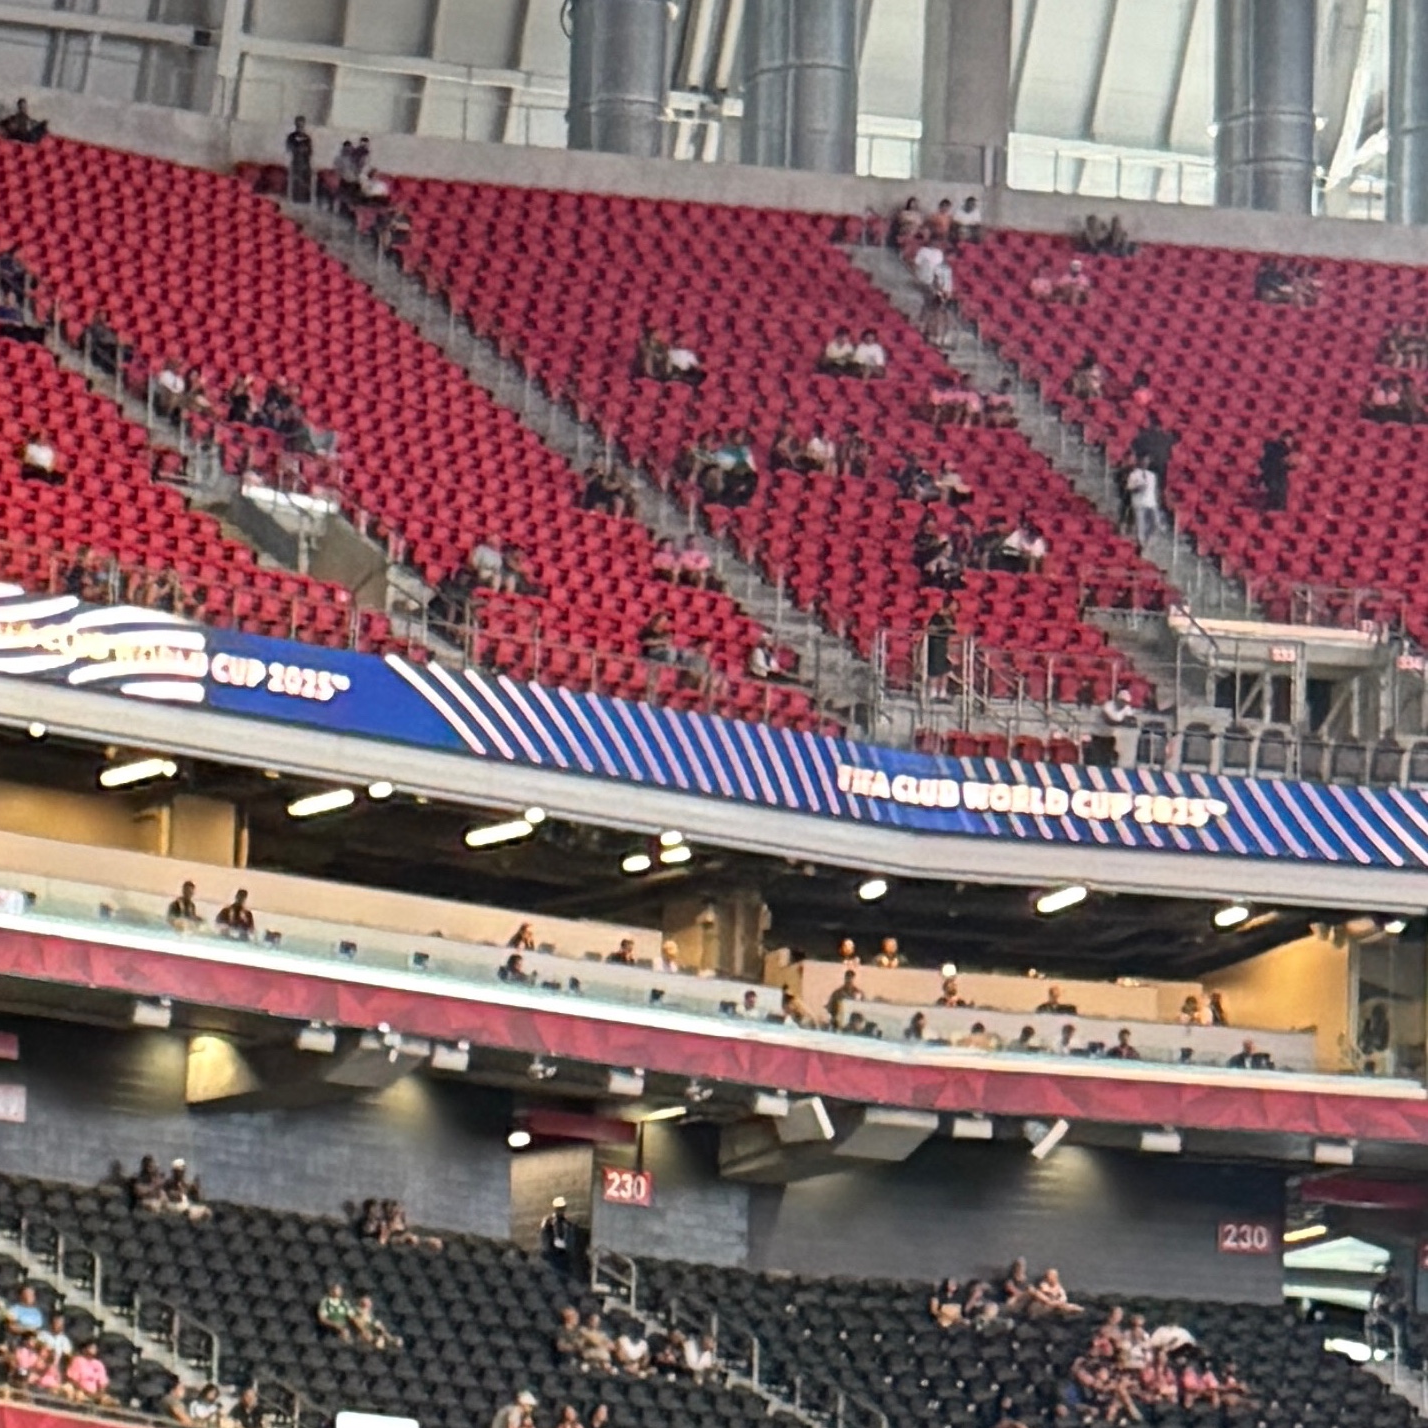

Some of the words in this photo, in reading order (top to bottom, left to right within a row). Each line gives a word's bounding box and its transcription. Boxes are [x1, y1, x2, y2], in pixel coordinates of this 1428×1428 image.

[211, 652, 267, 688] CUP
[837, 764, 891, 799] FIFA
[891, 774, 960, 808] CLUB
[962, 781, 1069, 815] WORLD
[1070, 789, 1133, 821] CUP
[606, 1171, 647, 1200] 230
[1222, 1223, 1269, 1250] 230
